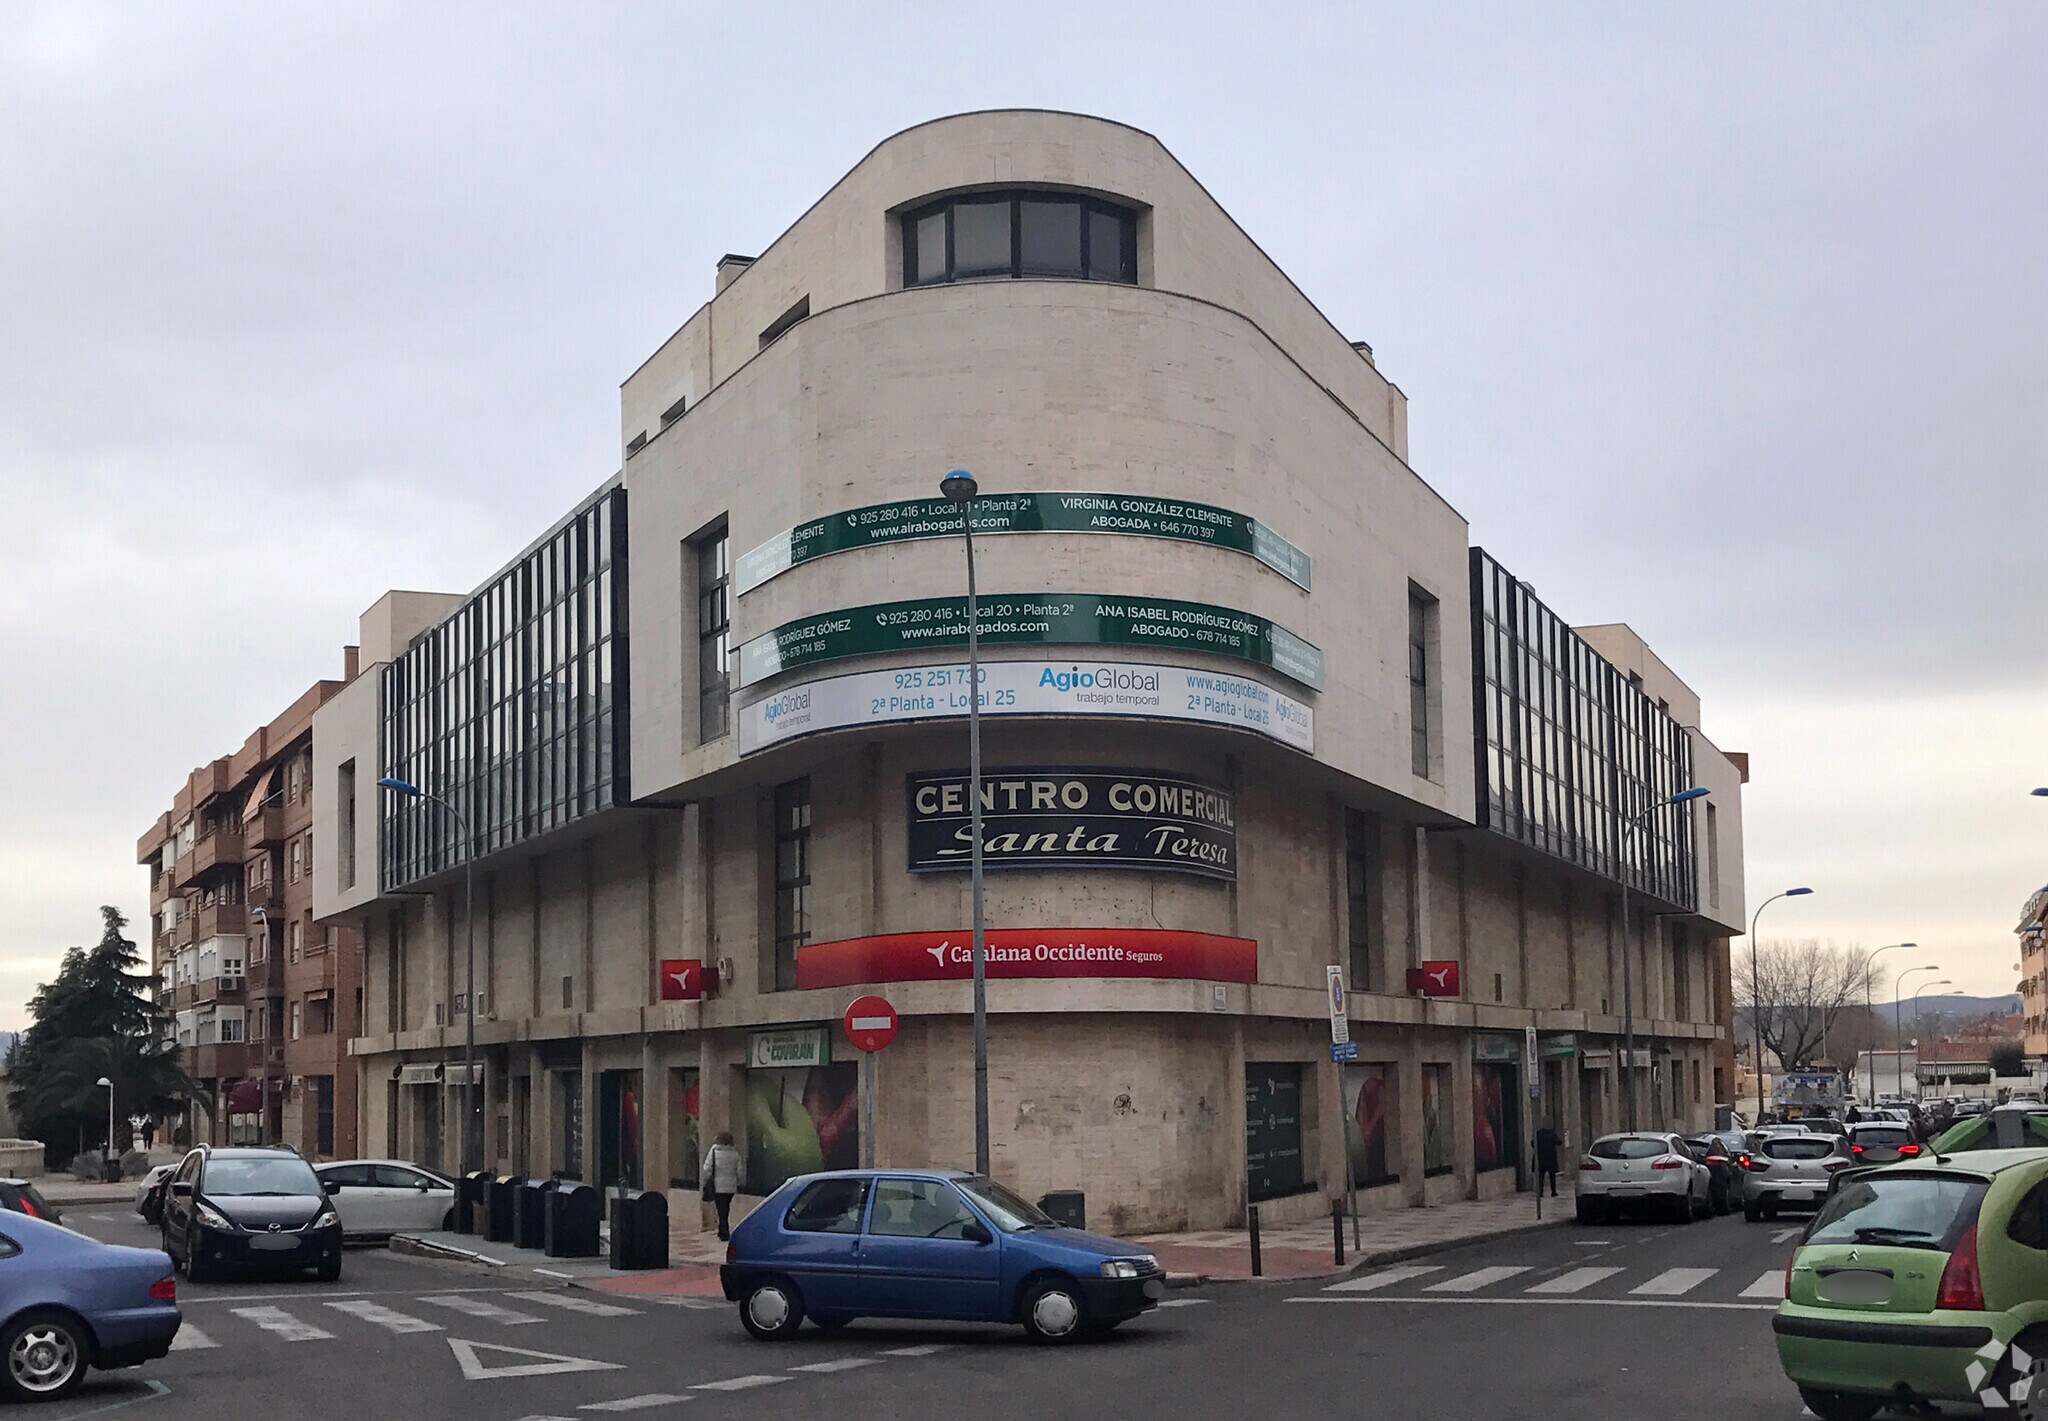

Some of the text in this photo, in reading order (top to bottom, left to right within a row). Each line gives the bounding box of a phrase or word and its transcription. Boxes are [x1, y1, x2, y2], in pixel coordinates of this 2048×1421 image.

[860, 511, 878, 525] 925
[880, 508, 899, 522] 280
[901, 506, 919, 519] 416
[929, 502, 957, 516] Local
[982, 500, 1017, 512] Planta
[1061, 498, 1233, 527] VIRGINIA GONZÁLEZ CLEMENTE
[1091, 516, 1215, 539] ABOGADA 646 770 397
[889, 604, 1074, 625] 925 280 416 Lcal 20 Planta 2ª
[1095, 605, 1259, 637] ANA ISABEL RODRÍGUEZ GÓMEZ
[779, 628, 816, 646] RODRÍGUEZ
[817, 619, 852, 636] GÓMEZ
[1131, 624, 1241, 647] ABOGADO 678 714 185
[801, 643, 813, 654] 714
[814, 640, 826, 652] 185
[895, 672, 922, 690] 925
[927, 670, 951, 687] 251
[1039, 666, 1159, 692] AgioGlobal
[1187, 677, 1269, 703] www.agioglobal.com
[872, 697, 886, 715] 2ª
[890, 695, 935, 712] Planta
[995, 690, 1016, 706] 25
[1077, 692, 1160, 706] trabajo temporal
[1188, 695, 1201, 710] 2ª
[1205, 697, 1236, 716] Planta
[1244, 704, 1262, 722] Local
[916, 781, 1234, 827] CENTRO COMERCIAL
[937, 822, 1228, 865] Santa Teresa
[951, 944, 1163, 964] Caalana Occidente Seguros
